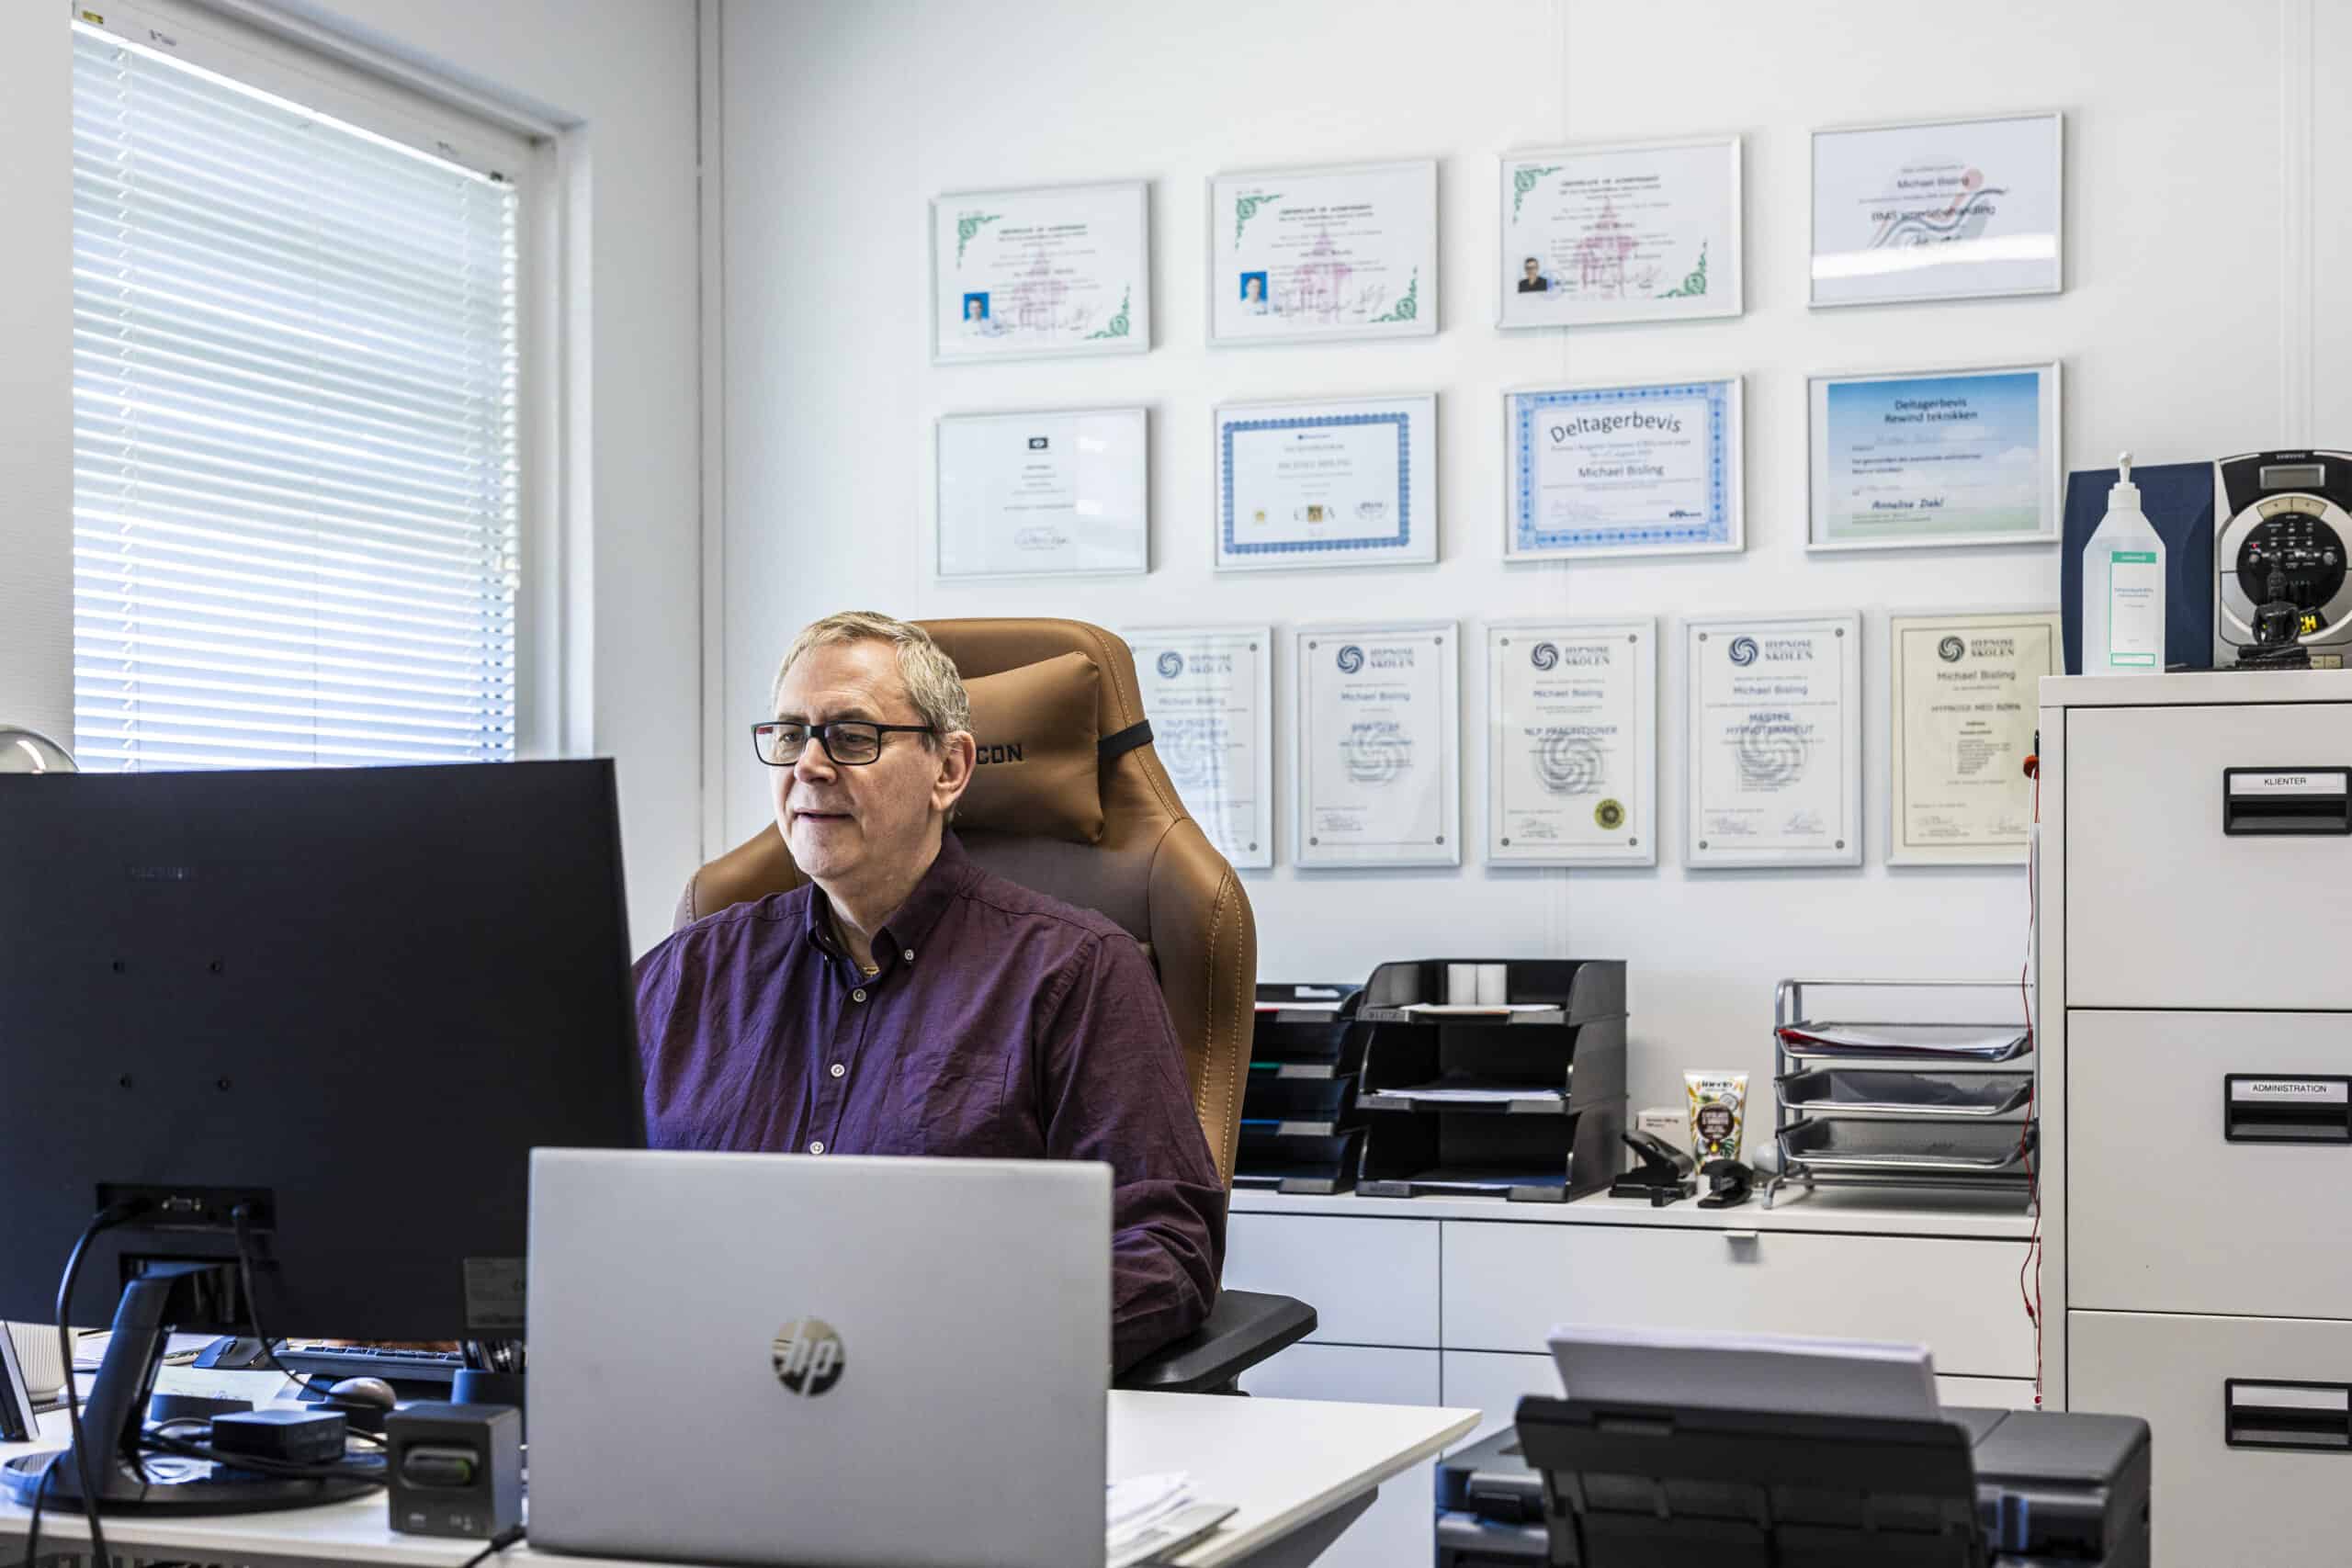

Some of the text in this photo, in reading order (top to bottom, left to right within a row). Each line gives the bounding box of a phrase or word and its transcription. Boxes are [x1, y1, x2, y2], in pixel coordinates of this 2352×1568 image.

[1550, 410, 1682, 443] Deltagerbevis
[1577, 465, 1624, 479] Michael
[2263, 776, 2307, 787] KLIENTER
[2251, 1083, 2327, 1093] ADMINISTRATION
[781, 1319, 841, 1396] hp
